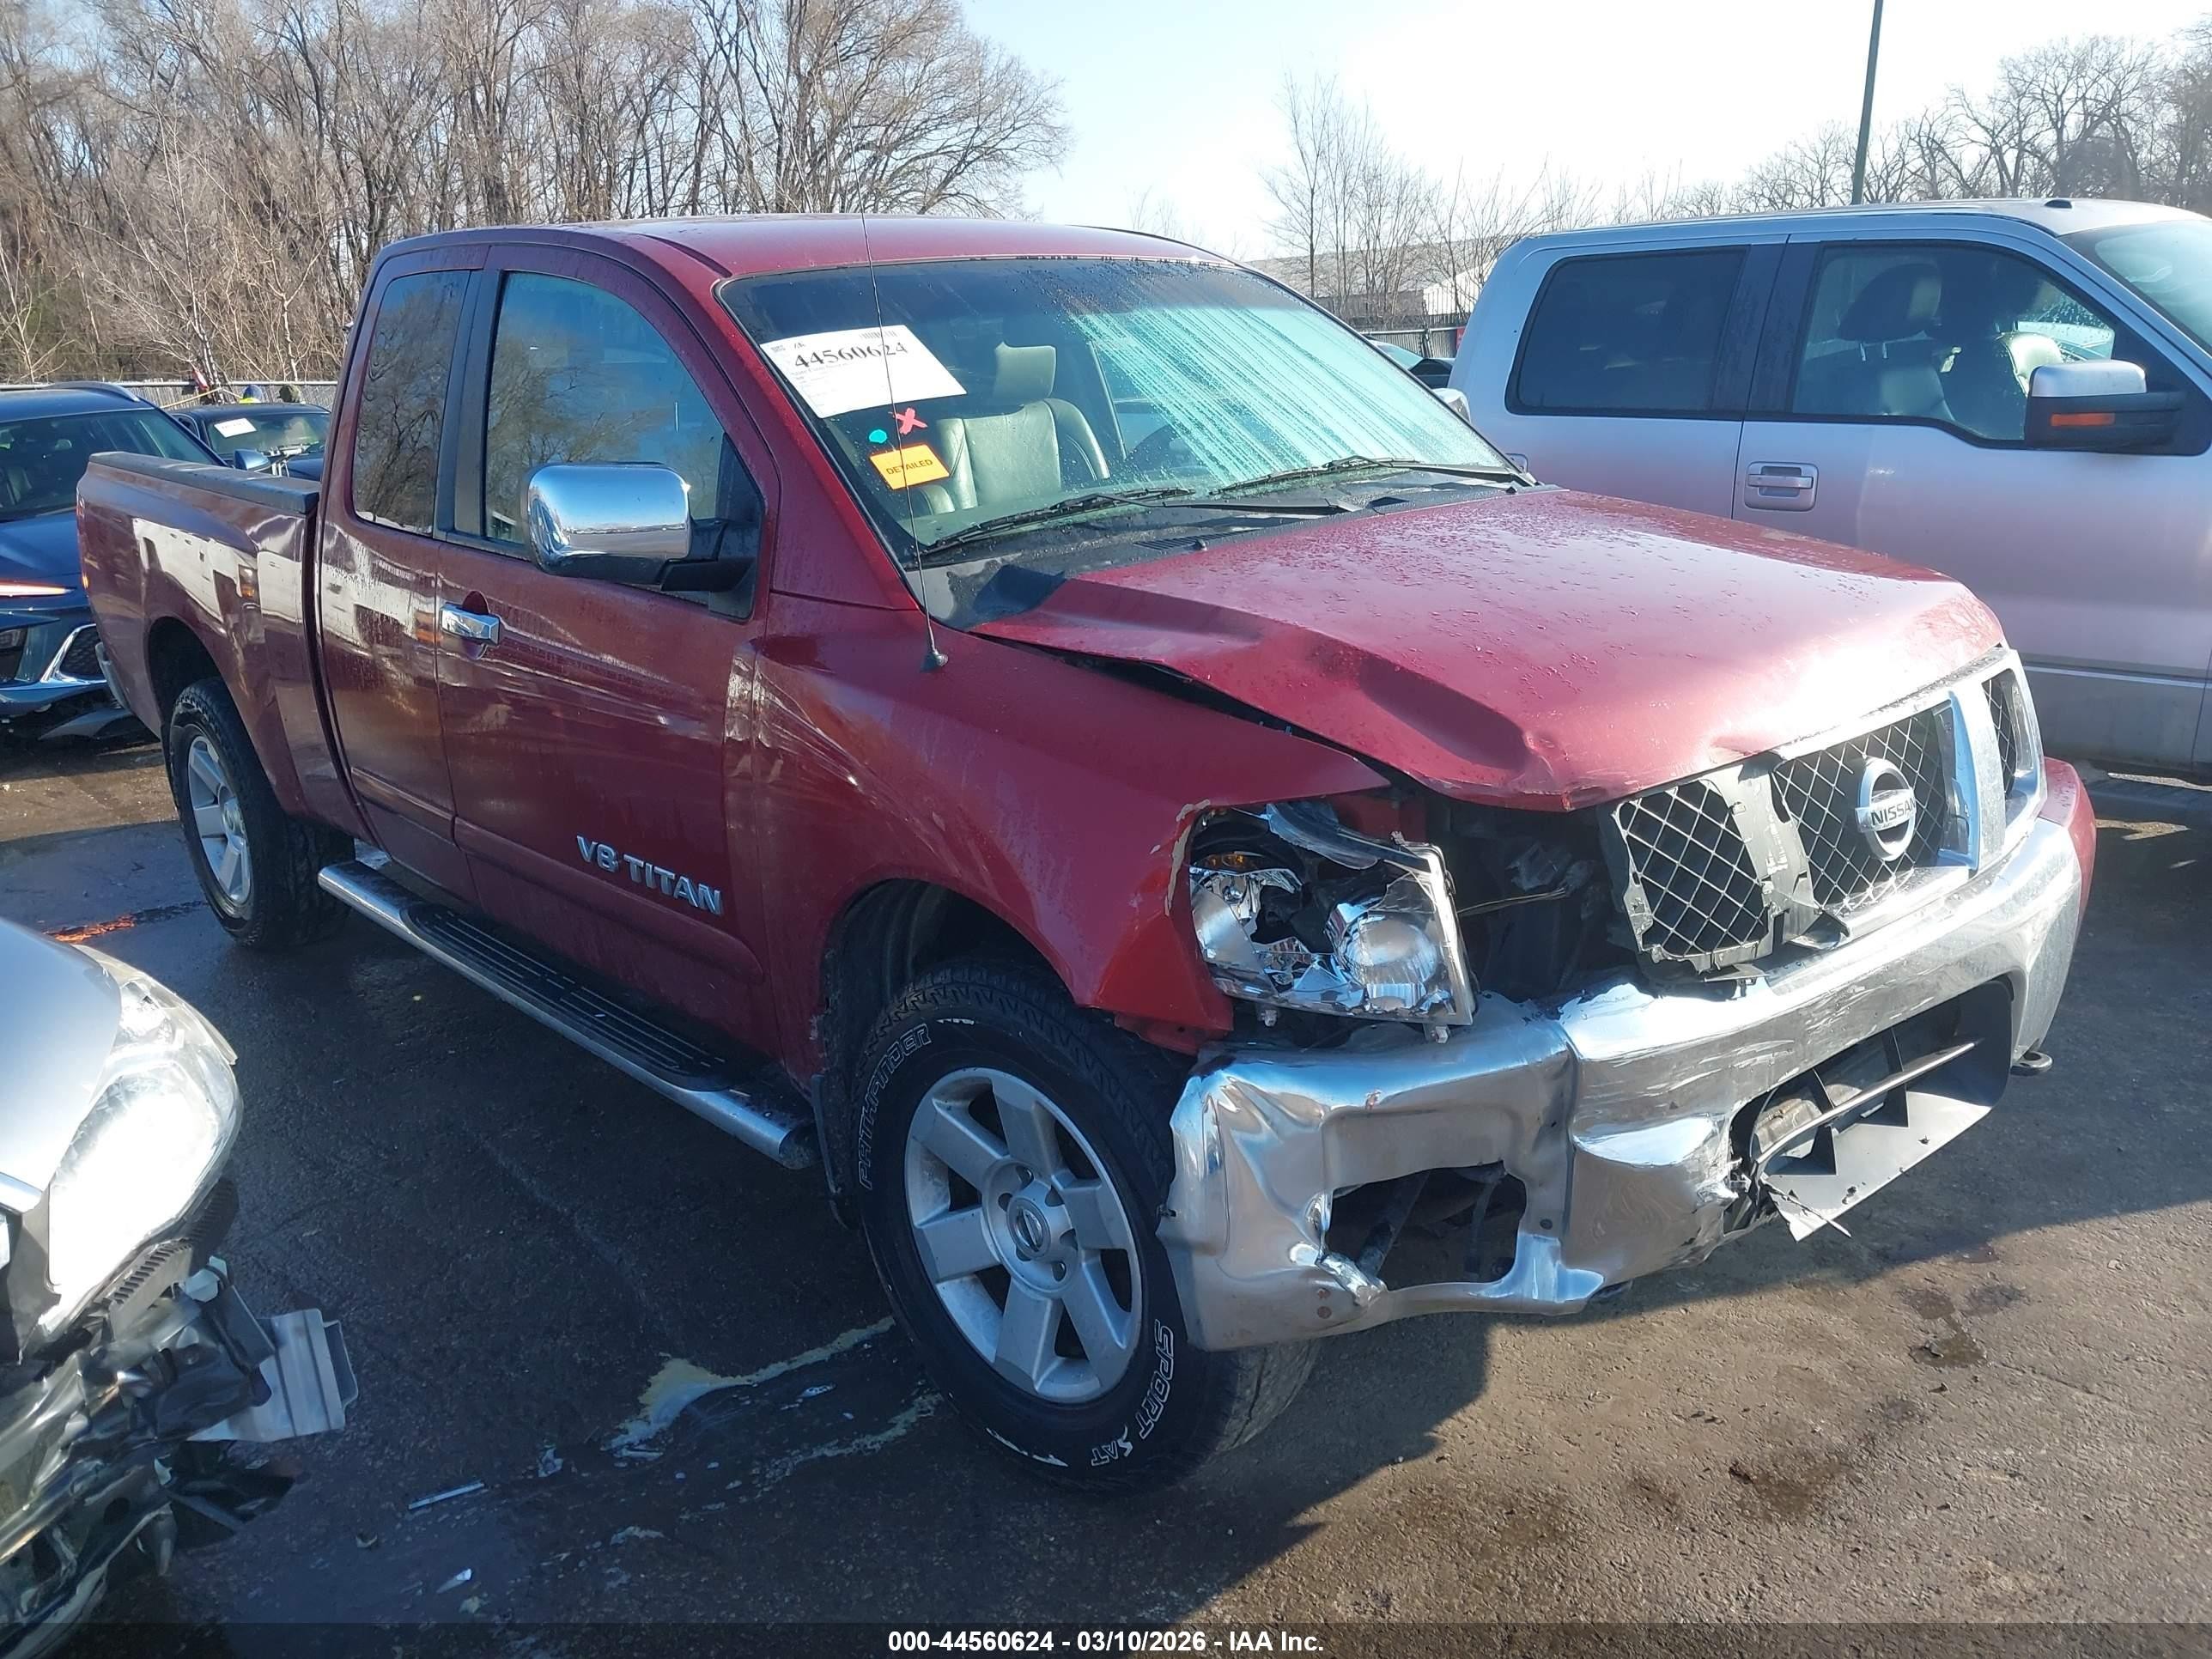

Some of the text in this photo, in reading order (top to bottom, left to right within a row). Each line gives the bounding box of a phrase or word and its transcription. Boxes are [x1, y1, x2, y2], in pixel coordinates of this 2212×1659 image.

[795, 342, 908, 368] 44560624
[886, 458, 933, 476] DETAILED
[1870, 798, 1915, 826] NISSAN
[576, 835, 724, 916] V8 TITAN
[859, 1023, 932, 1191] PATHFINDER
[1135, 1319, 1174, 1439] SPORT
